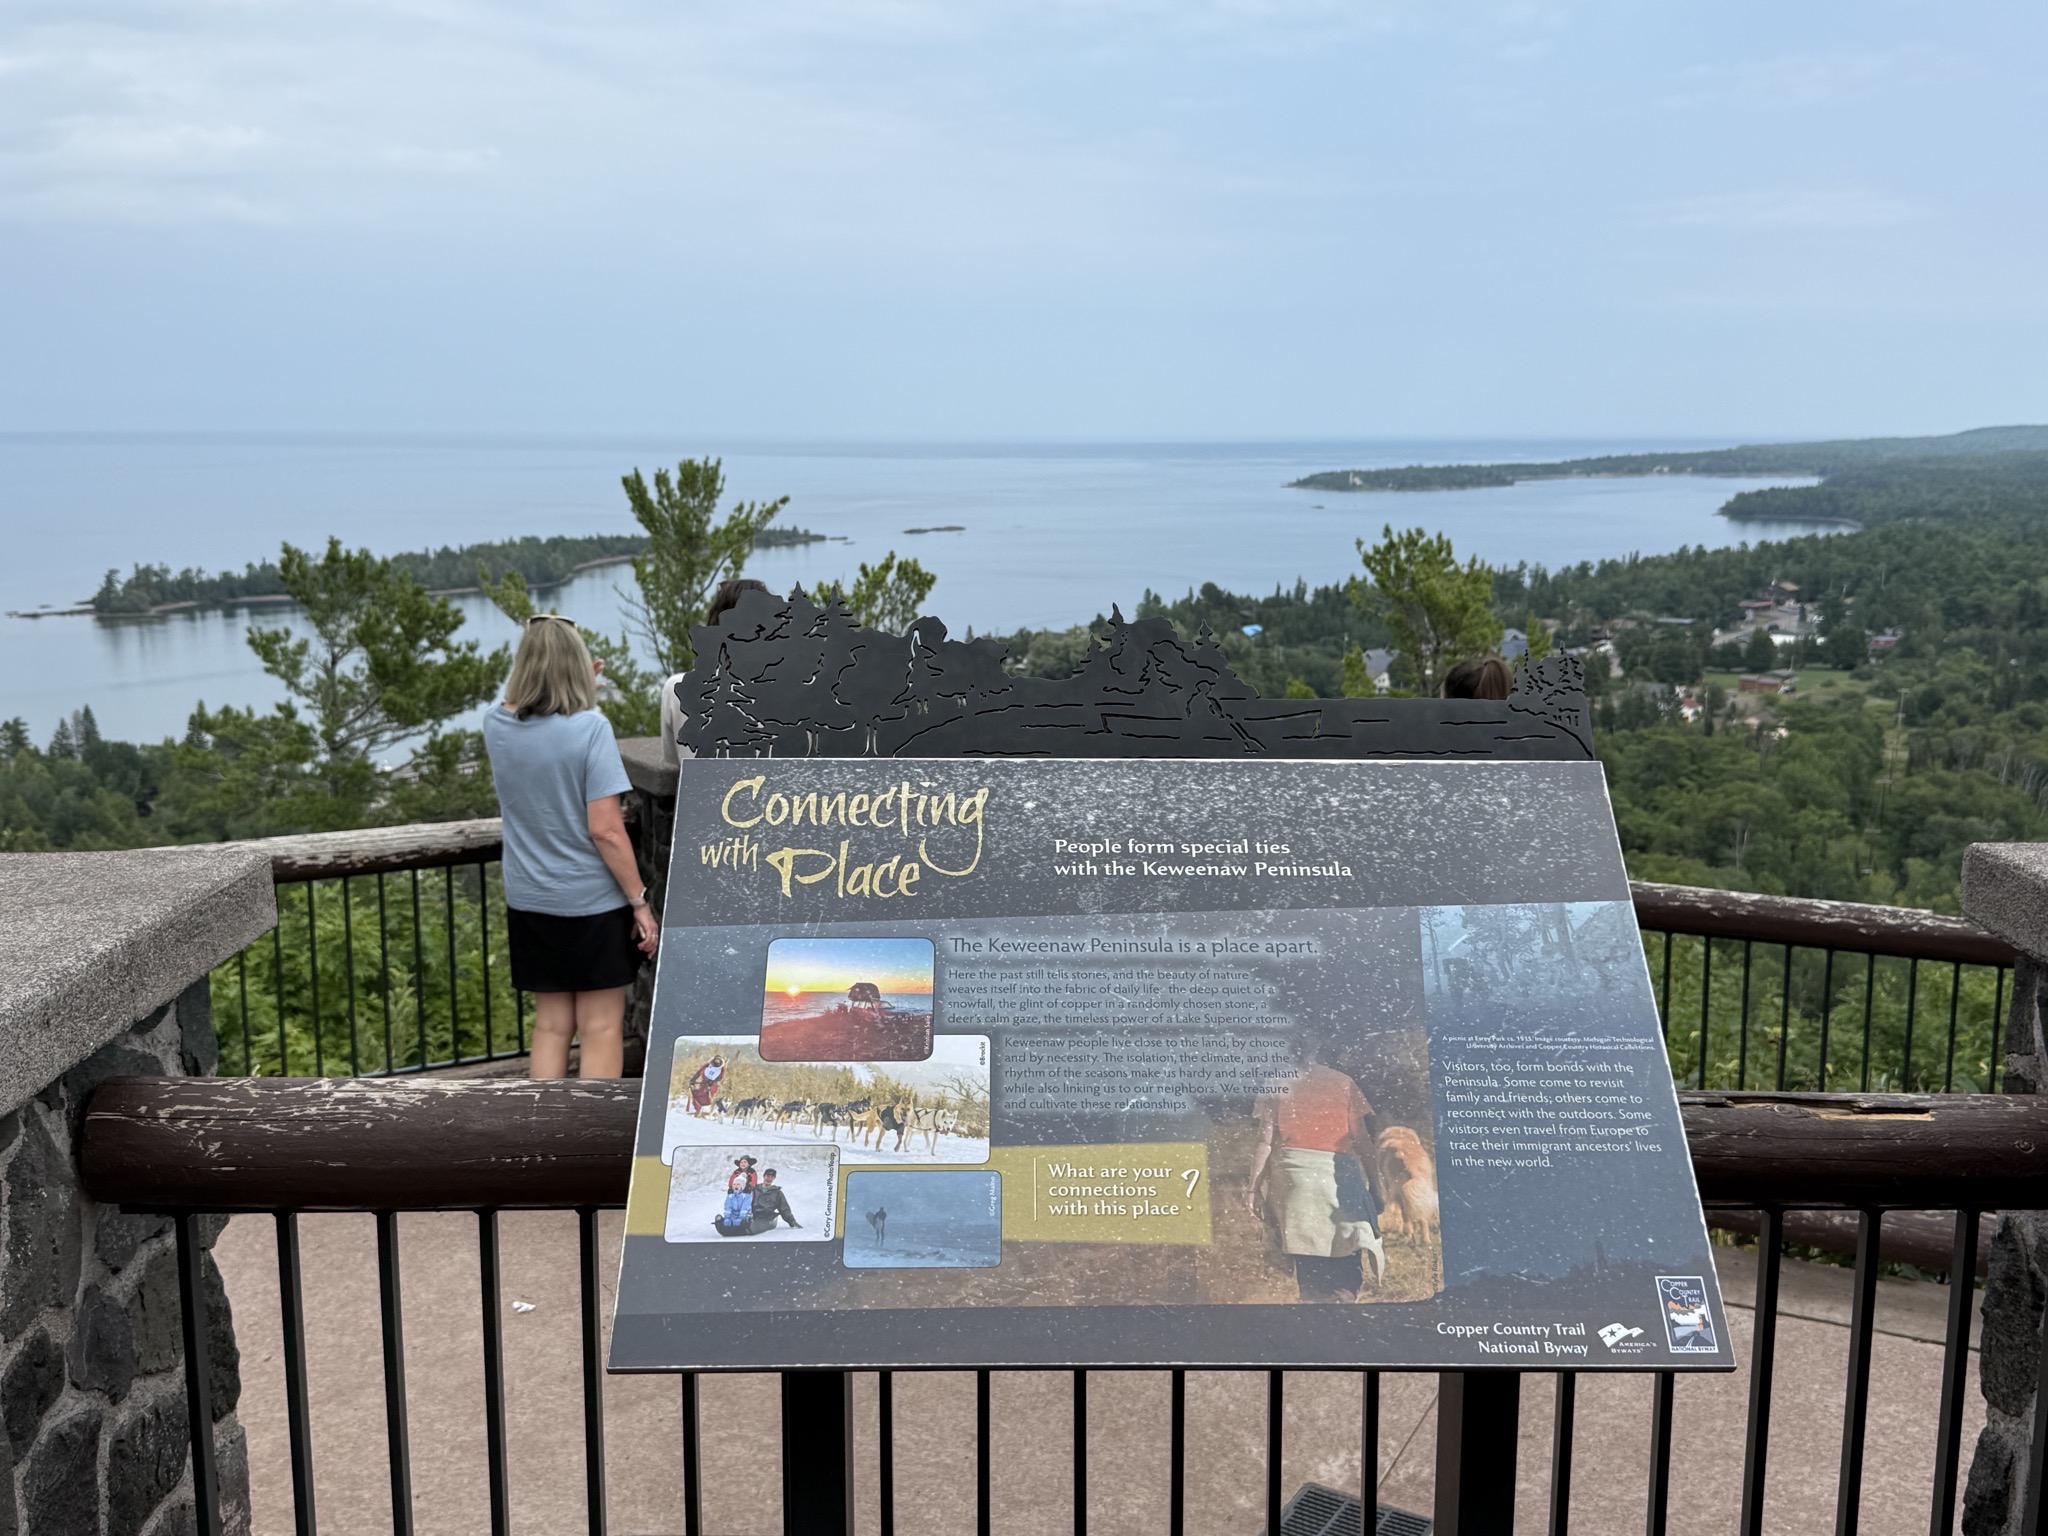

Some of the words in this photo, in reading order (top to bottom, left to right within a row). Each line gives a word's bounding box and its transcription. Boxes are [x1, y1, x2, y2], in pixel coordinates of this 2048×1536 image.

[721, 775, 989, 876] Connecting
[1055, 839, 1122, 857] People
[1128, 838, 1175, 854] form
[1181, 839, 1249, 857] special
[1255, 840, 1290, 854] ties
[701, 835, 758, 872] with
[765, 839, 920, 898] Place
[1054, 861, 1098, 876] with
[1104, 861, 1136, 876] the
[1143, 861, 1247, 876] Keweenaw
[1255, 861, 1352, 877] Peninsula
[950, 937, 982, 953] The
[989, 937, 1086, 953] Keweenaw
[1091, 937, 1173, 953] Peninsula
[1178, 937, 1191, 953] is
[1196, 942, 1206, 953] a
[1212, 937, 1259, 957] place
[1265, 939, 1317, 957] apart.
[949, 970, 976, 980] Here
[979, 969, 997, 980] the
[1000, 970, 1023, 982] past
[1026, 969, 1044, 980] still
[1047, 969, 1069, 980] tells
[1071, 970, 1110, 981] stories,
[1113, 969, 1133, 980] and
[1137, 969, 1154, 980] the
[1158, 969, 1196, 982] beauty
[1199, 969, 1211, 980] of
[1213, 971, 1249, 980] nature
[984, 1013, 1010, 1024] calm
[1013, 1016, 1041, 1026] gaze,
[1044, 1013, 1062, 1024] the
[1065, 1013, 1109, 1024] timeless
[1112, 1015, 1148, 1026] power
[1152, 1013, 1164, 1024] of
[1167, 1016, 1173, 1024] a
[1175, 1013, 1201, 1024] Lake
[1204, 1014, 1251, 1026] Superior
[1256, 1015, 1291, 1024] storm.
[1005, 1037, 1065, 1047] Keweenaw
[1068, 1037, 1109, 1050] people
[1112, 1037, 1132, 1047] live
[1134, 1037, 1163, 1047] close
[1166, 1039, 1178, 1048] to
[1181, 1037, 1199, 1048] the
[1202, 1037, 1229, 1049] land,
[1232, 1037, 1246, 1050] by
[1249, 1037, 1286, 1048] choice
[1005, 1052, 1026, 1062] and
[1029, 1052, 1044, 1065] by
[1047, 1053, 1099, 1065] necessity.
[1102, 1052, 1124, 1062] The
[1127, 1052, 1177, 1064] isolation,
[1180, 1052, 1198, 1063] the
[1201, 1052, 1244, 1064] climate,
[1247, 1052, 1268, 1063] and
[1271, 1053, 1290, 1063] the
[1442, 1061, 1488, 1073] Visitors,
[1491, 1062, 1513, 1073] too,
[1517, 1060, 1544, 1072] form
[1547, 1061, 1584, 1072] bonds
[1586, 1061, 1611, 1072] with
[1614, 1061, 1633, 1073] the
[1005, 1067, 1045, 1080] rhythm
[1048, 1067, 1061, 1078] of
[1063, 1067, 1081, 1078] the
[1085, 1070, 1128, 1078] seasons
[1131, 1068, 1161, 1078] make
[1180, 1068, 1212, 1081] hardy
[1215, 1068, 1236, 1078] and
[1240, 1068, 1299, 1079] self-reliant
[1445, 1076, 1501, 1087] Peninsula.
[1504, 1077, 1537, 1087] Some
[1540, 1079, 1572, 1088] come
[1575, 1078, 1587, 1088] to
[1590, 1077, 1624, 1088] revisit
[1004, 1083, 1035, 1093] while
[1038, 1083, 1060, 1093] also
[1063, 1083, 1101, 1097] linking
[1119, 1084, 1131, 1093] to
[1134, 1086, 1153, 1094] our
[1157, 1083, 1217, 1096] neighbors.
[1219, 1083, 1240, 1093] We
[1243, 1085, 1289, 1094] treasure
[1446, 1091, 1480, 1106] family
[1483, 1092, 1505, 1103] and
[1508, 1091, 1552, 1104] friends;
[1555, 1092, 1591, 1103] others
[1595, 1095, 1626, 1104] come
[1630, 1094, 1642, 1104] to
[1447, 1108, 1505, 1119] reconnect
[1508, 1107, 1534, 1119] with
[1537, 1108, 1556, 1119] the
[1559, 1108, 1616, 1119] outdoors.
[1619, 1109, 1652, 1120] Some
[1448, 1123, 1489, 1134] visitors
[1492, 1126, 1520, 1134] even
[1524, 1124, 1556, 1135] travel
[1559, 1124, 1587, 1135] from
[1590, 1125, 1632, 1138] Europe
[1636, 1126, 1649, 1136] to
[1450, 1141, 1479, 1150] trace
[1482, 1140, 1509, 1151] their
[1513, 1140, 1572, 1154] immigrant
[1636, 1141, 1662, 1152] lives
[1451, 1156, 1462, 1166] in
[1465, 1155, 1484, 1166] the
[1488, 1158, 1512, 1167] new
[1515, 1156, 1553, 1167] world.
[1048, 1163, 1095, 1178] What
[1100, 1167, 1128, 1178] are
[1133, 1167, 1172, 1181] your
[1049, 1183, 1157, 1197] connections
[1049, 1200, 1088, 1216] with
[1094, 1200, 1126, 1216] this
[1132, 1200, 1179, 1219] place
[1437, 1322, 1489, 1337] Copper
[1493, 1323, 1551, 1337] Country
[1553, 1322, 1585, 1336] Trail
[1478, 1341, 1539, 1354] National
[1543, 1342, 1588, 1357] Byway
